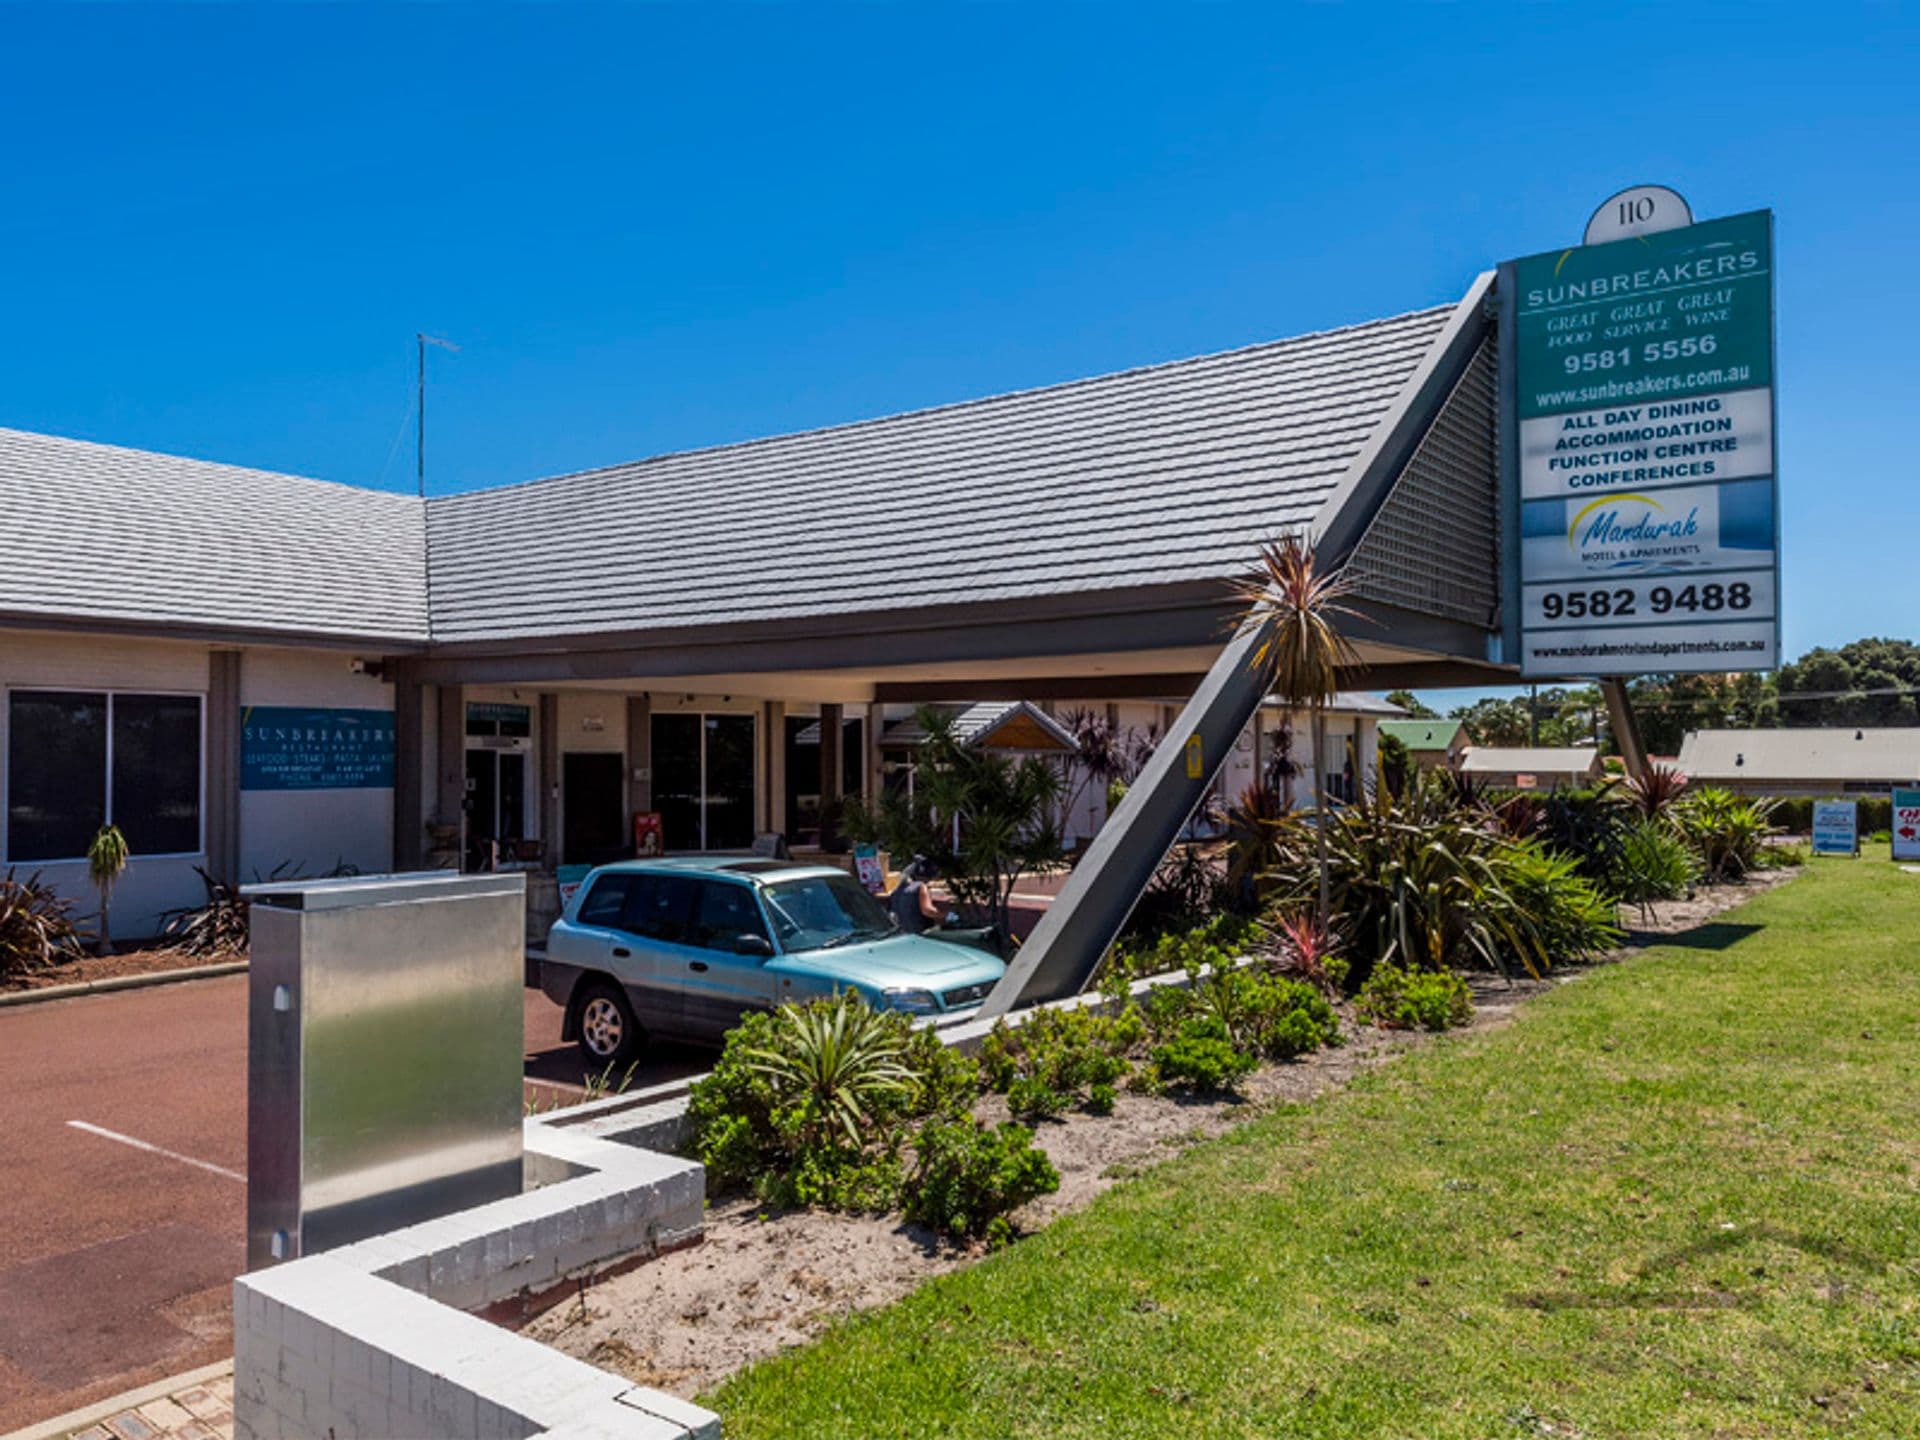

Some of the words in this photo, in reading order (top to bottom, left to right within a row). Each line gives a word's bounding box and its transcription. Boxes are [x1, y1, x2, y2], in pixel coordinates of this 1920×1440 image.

[1619, 197, 1655, 225] 110
[1528, 251, 1758, 307] SUNBREAKERS
[1547, 311, 1599, 333] GREAT
[1610, 300, 1665, 322] GREAT
[1677, 288, 1737, 311] GREAT
[1603, 318, 1672, 340] SERVICE
[1685, 308, 1732, 326] WINE
[1564, 348, 1631, 374] 9581
[1643, 334, 1717, 363] 5556
[1536, 365, 1750, 408] www.sunbreakers.com.au
[1562, 416, 1598, 431] ALL
[1604, 408, 1643, 427] DAY
[1648, 398, 1722, 420] DINING
[1554, 418, 1732, 450] ACCOMMODATION
[1549, 448, 1649, 471] FUNCTION
[1654, 437, 1738, 460] CENTRE
[1569, 461, 1716, 488] CONFERENCES
[1581, 507, 1699, 547] Mandurah
[1542, 589, 1637, 619] 9582
[1650, 582, 1752, 614] 9488
